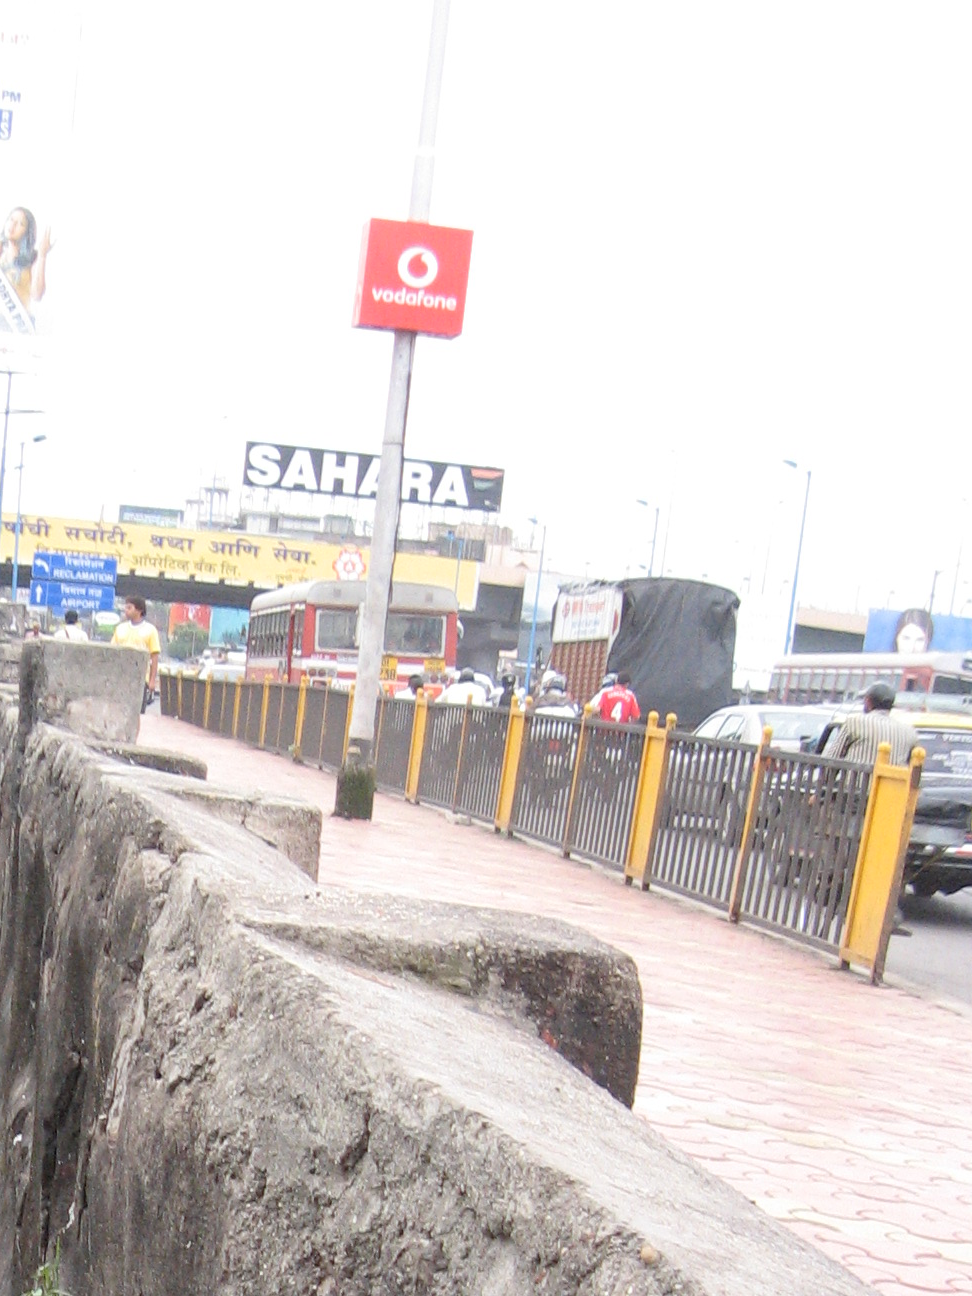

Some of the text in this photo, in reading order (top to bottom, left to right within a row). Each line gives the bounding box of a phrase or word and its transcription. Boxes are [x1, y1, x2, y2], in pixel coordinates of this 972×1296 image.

[1, 90, 22, 103] PM
[372, 287, 457, 312] vodafone
[247, 445, 470, 507] SAHARA
[208, 538, 262, 559] आणि
[52, 567, 115, 584] RECLAMATION
[60, 597, 101, 610] AIRPORT
